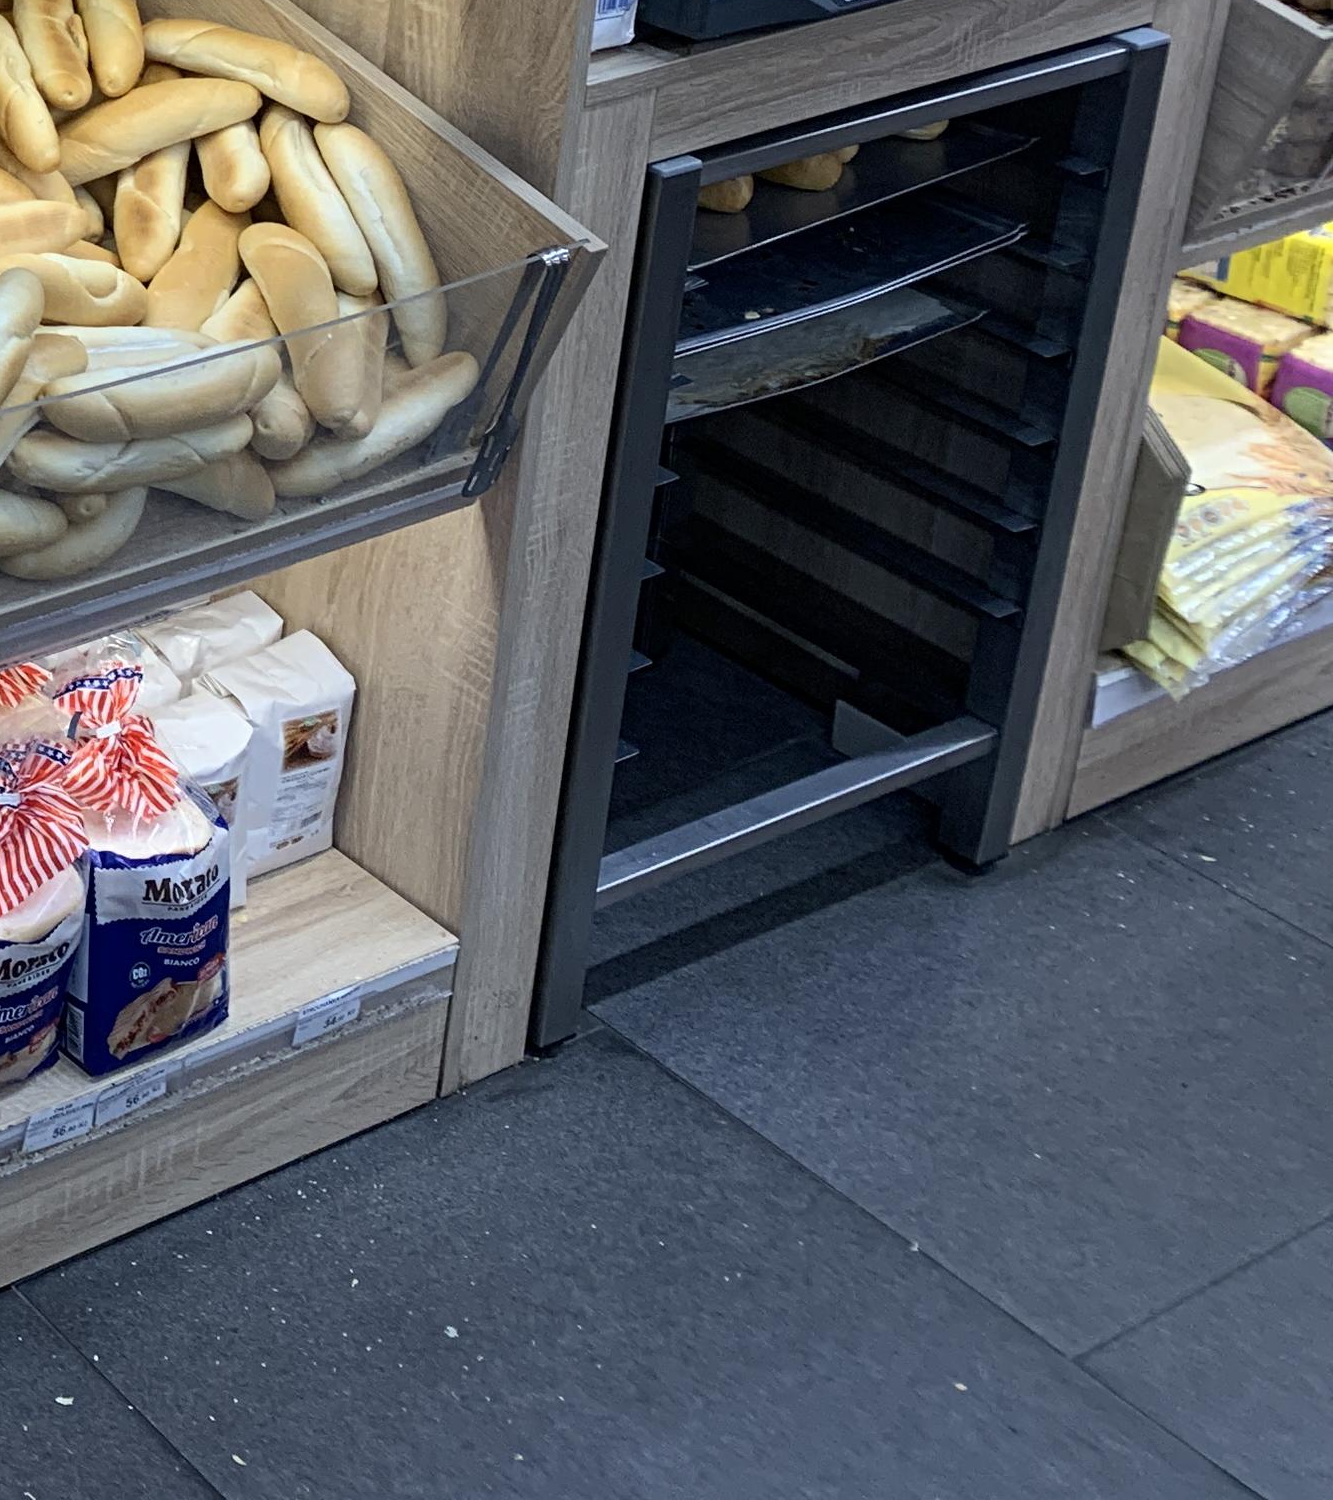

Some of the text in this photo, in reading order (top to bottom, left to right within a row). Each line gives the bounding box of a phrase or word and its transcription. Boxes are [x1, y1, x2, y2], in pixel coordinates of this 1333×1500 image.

[143, 864, 219, 904] Morato
[140, 914, 218, 945] American
[164, 957, 199, 966] BIANCO
